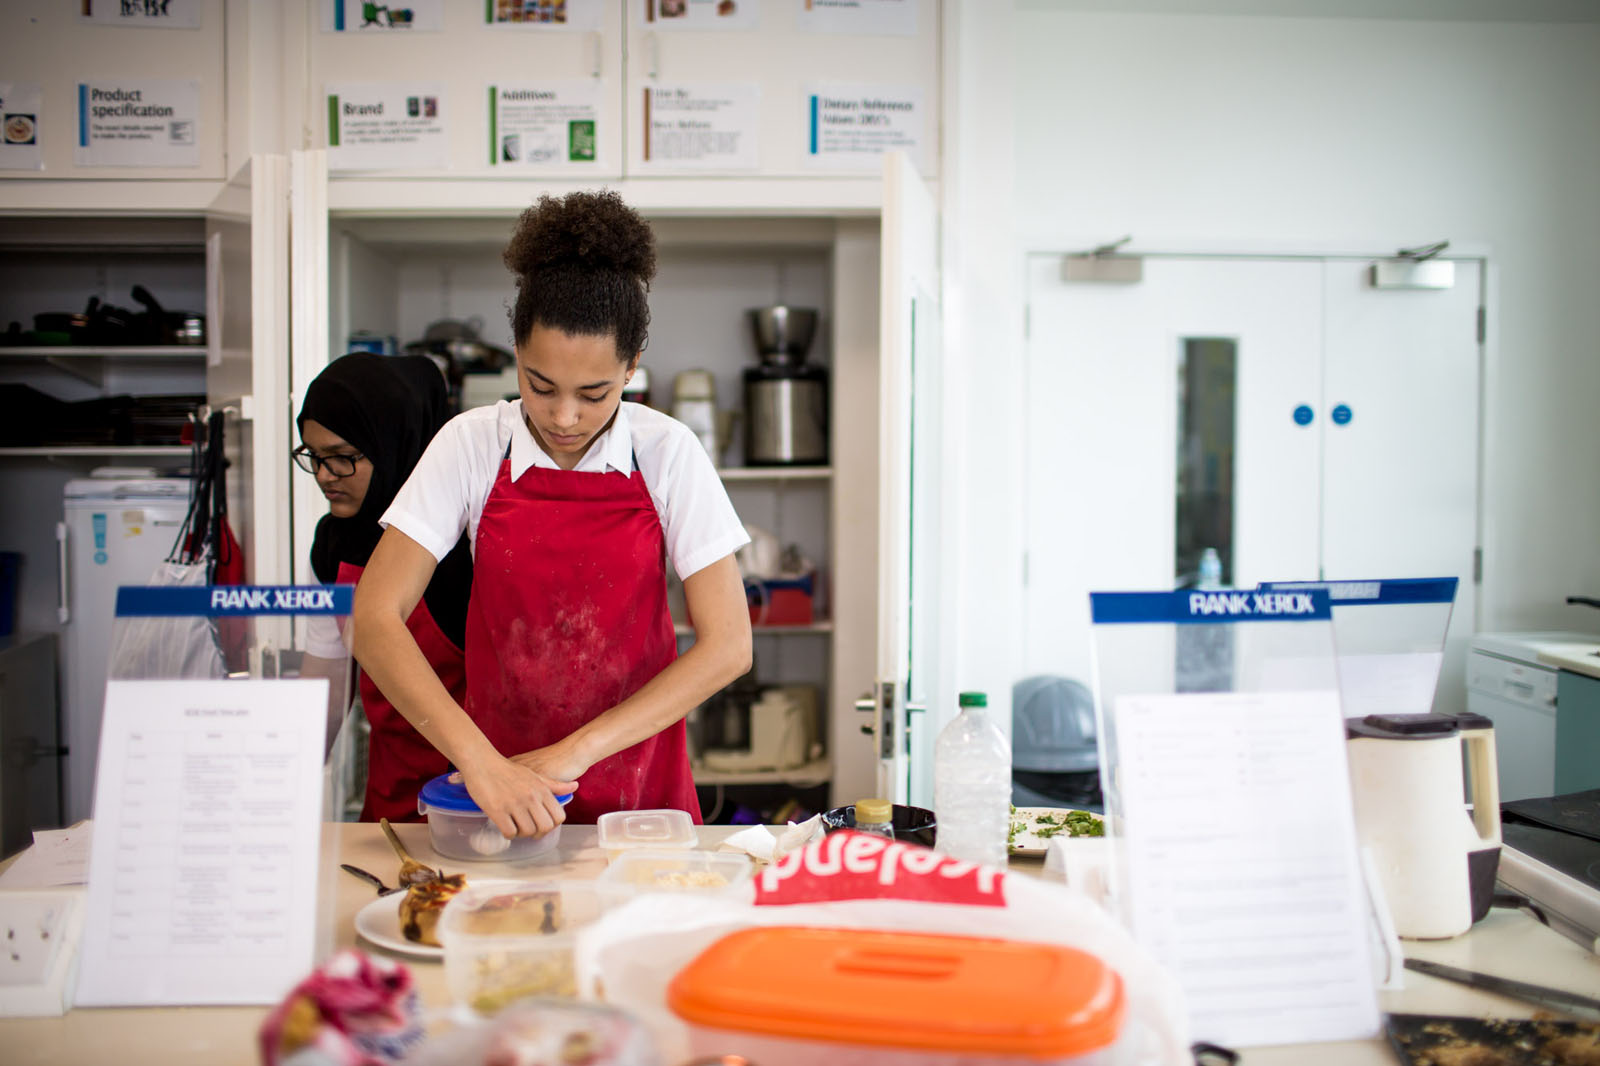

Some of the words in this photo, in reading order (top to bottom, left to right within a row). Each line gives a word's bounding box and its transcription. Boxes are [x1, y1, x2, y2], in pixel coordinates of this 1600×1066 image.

[91, 88, 141, 102] Product
[91, 103, 174, 118] specification
[343, 102, 384, 116] Brand
[211, 589, 271, 609] RANK
[272, 589, 335, 609] XEROX
[1189, 592, 1252, 616] RANK
[1252, 592, 1316, 615] XEROX
